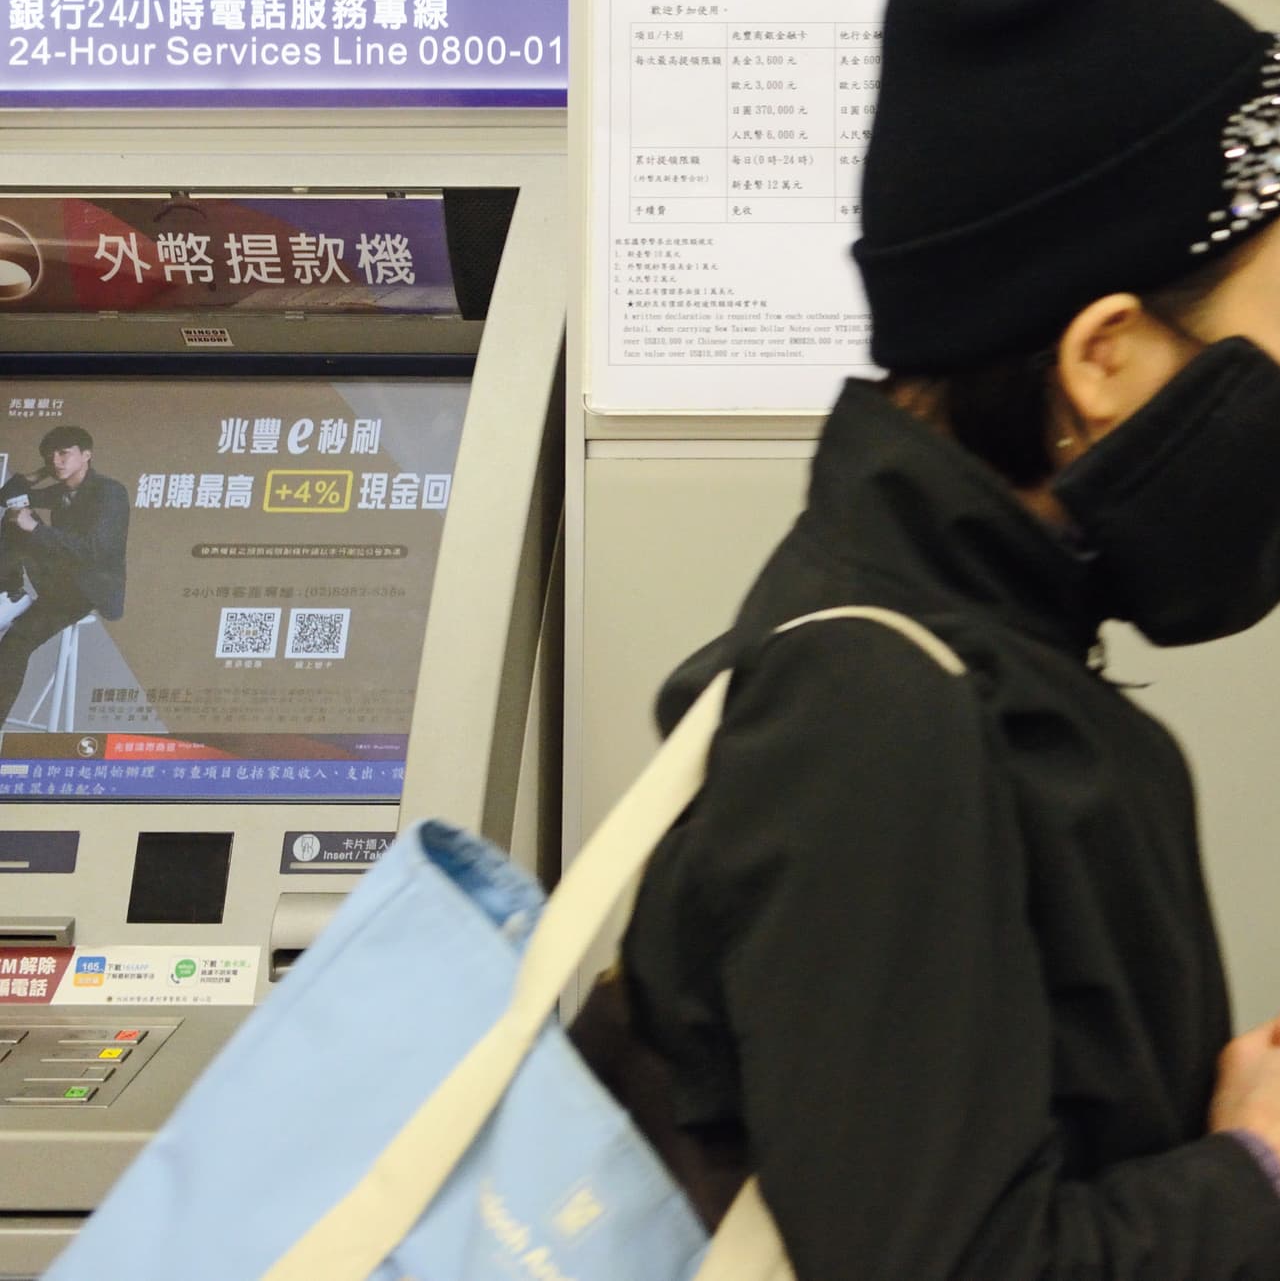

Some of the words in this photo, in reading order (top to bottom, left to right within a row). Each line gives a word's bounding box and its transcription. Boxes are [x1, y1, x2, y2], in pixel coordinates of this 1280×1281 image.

[9, 35, 156, 66] 24-Hour
[166, 35, 321, 66] Services
[334, 35, 407, 66] Line
[419, 35, 562, 65] 0800-01
[94, 232, 416, 286] 外幣提款機
[135, 473, 255, 509] 網購最高
[275, 479, 341, 506] +4%
[357, 473, 452, 509] 現金回
[323, 851, 353, 860] Insert
